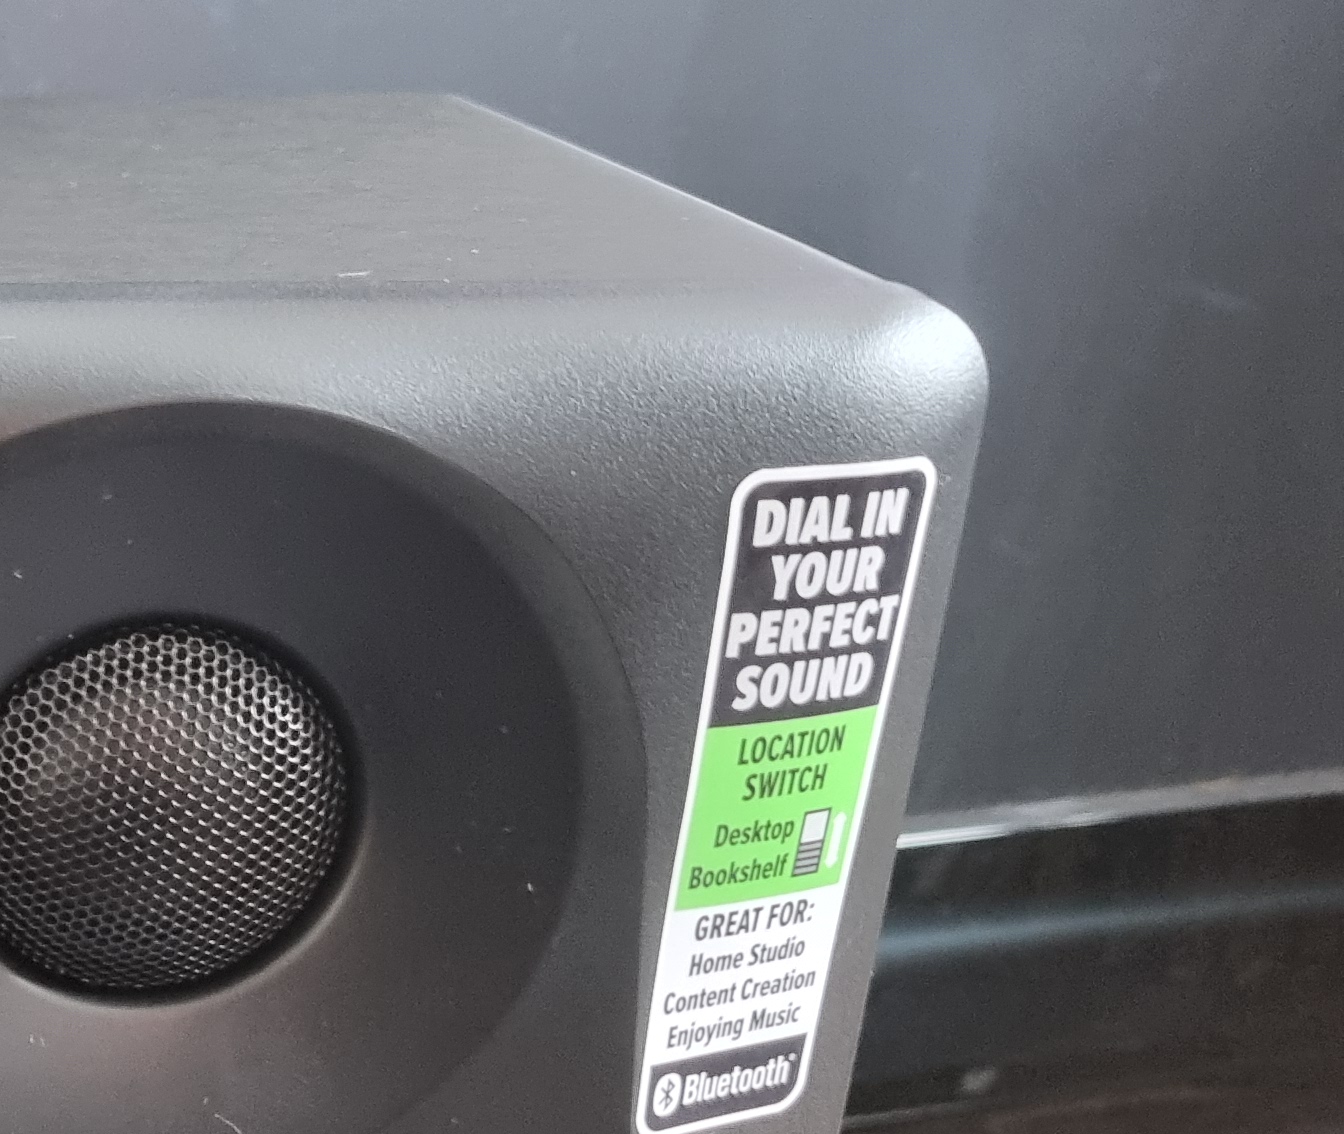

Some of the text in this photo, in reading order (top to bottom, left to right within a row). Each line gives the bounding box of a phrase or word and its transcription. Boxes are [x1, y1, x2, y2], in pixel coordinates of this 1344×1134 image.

[753, 487, 909, 547] DIAL IN
[771, 545, 885, 600] YOUR
[725, 594, 899, 658] PERFECT
[731, 652, 873, 711] SOUND
[737, 725, 845, 765] LOCATION
[742, 763, 828, 801] SWITCH
[714, 819, 795, 848] Desktop
[688, 853, 788, 889] Bookshelf
[695, 899, 815, 941] GREAT FOR:
[688, 936, 805, 977] Home Studio
[663, 969, 816, 1015] Content Creation
[666, 1004, 801, 1050] Enjoying Music
